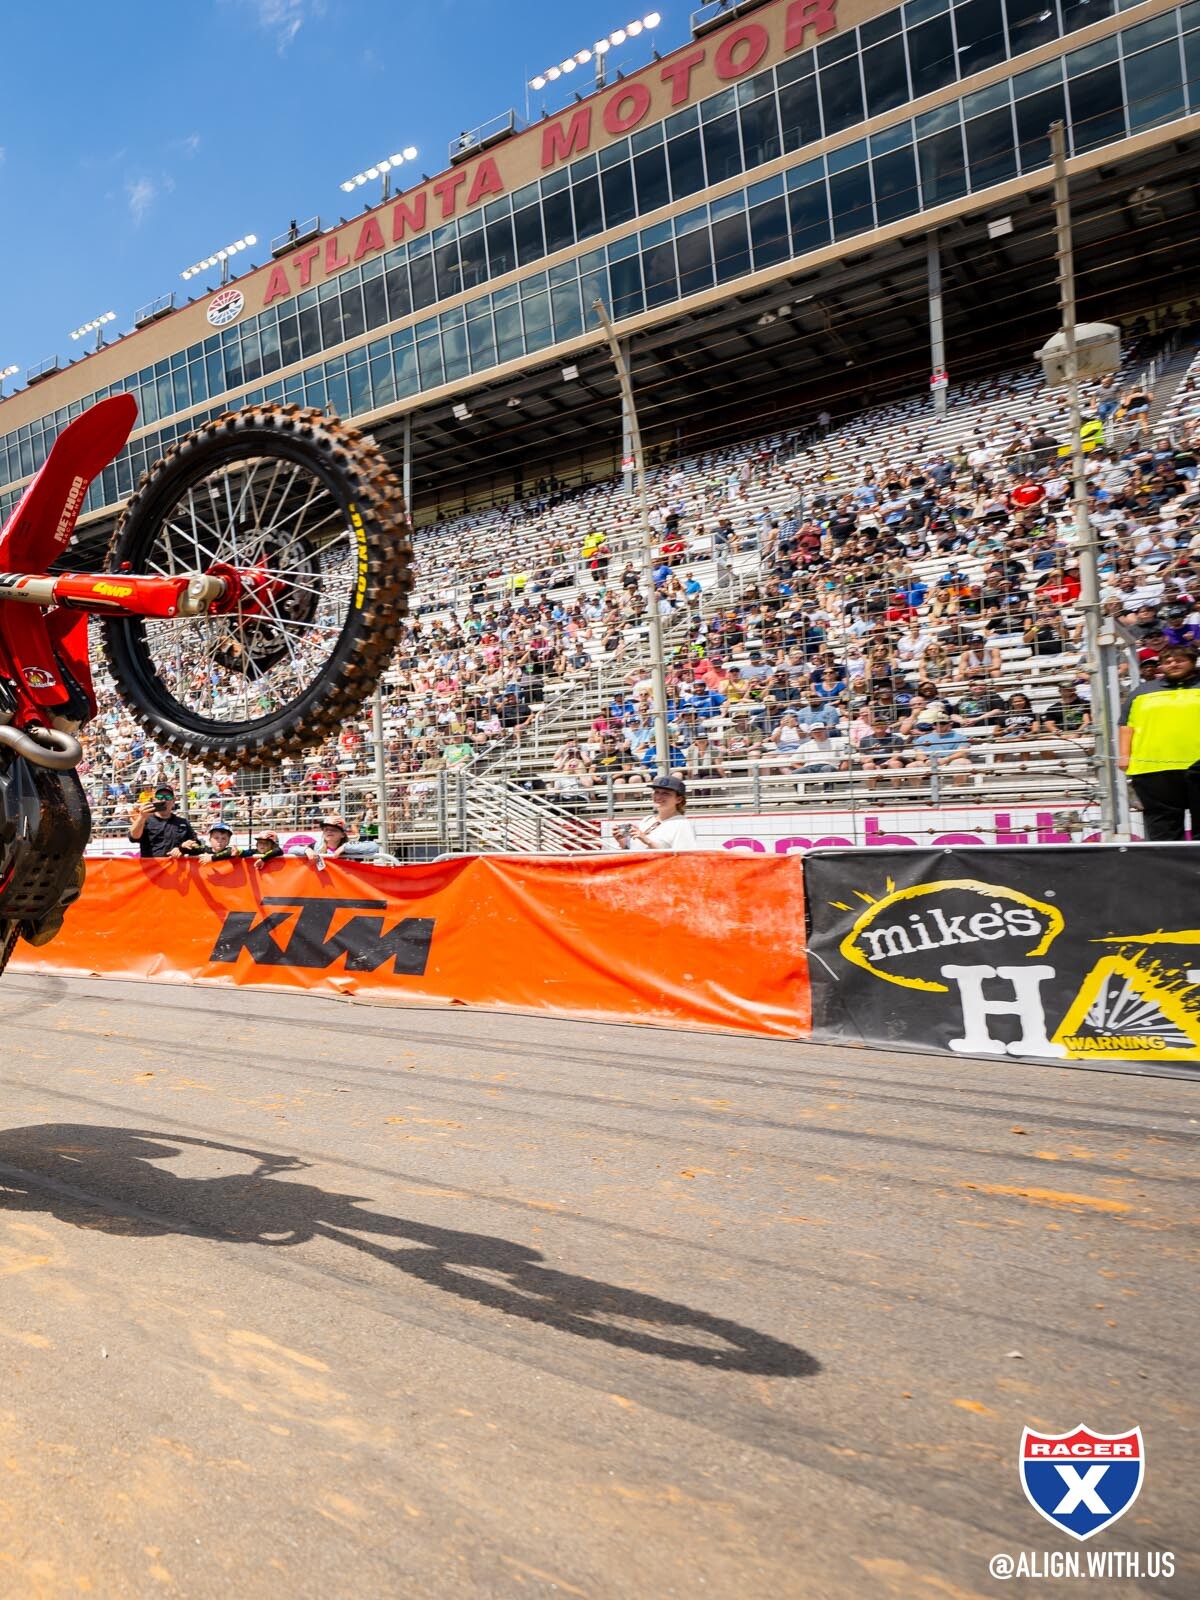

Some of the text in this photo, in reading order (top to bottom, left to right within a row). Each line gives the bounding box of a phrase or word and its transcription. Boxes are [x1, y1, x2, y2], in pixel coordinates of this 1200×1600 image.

[263, 0, 837, 306] ATLANTA MOTOR
[53, 475, 83, 542] METHOD
[351, 511, 369, 610] DUNLOP
[209, 896, 436, 976] KTM
[860, 902, 1043, 961] mike's
[1062, 1034, 1166, 1051] WARNING
